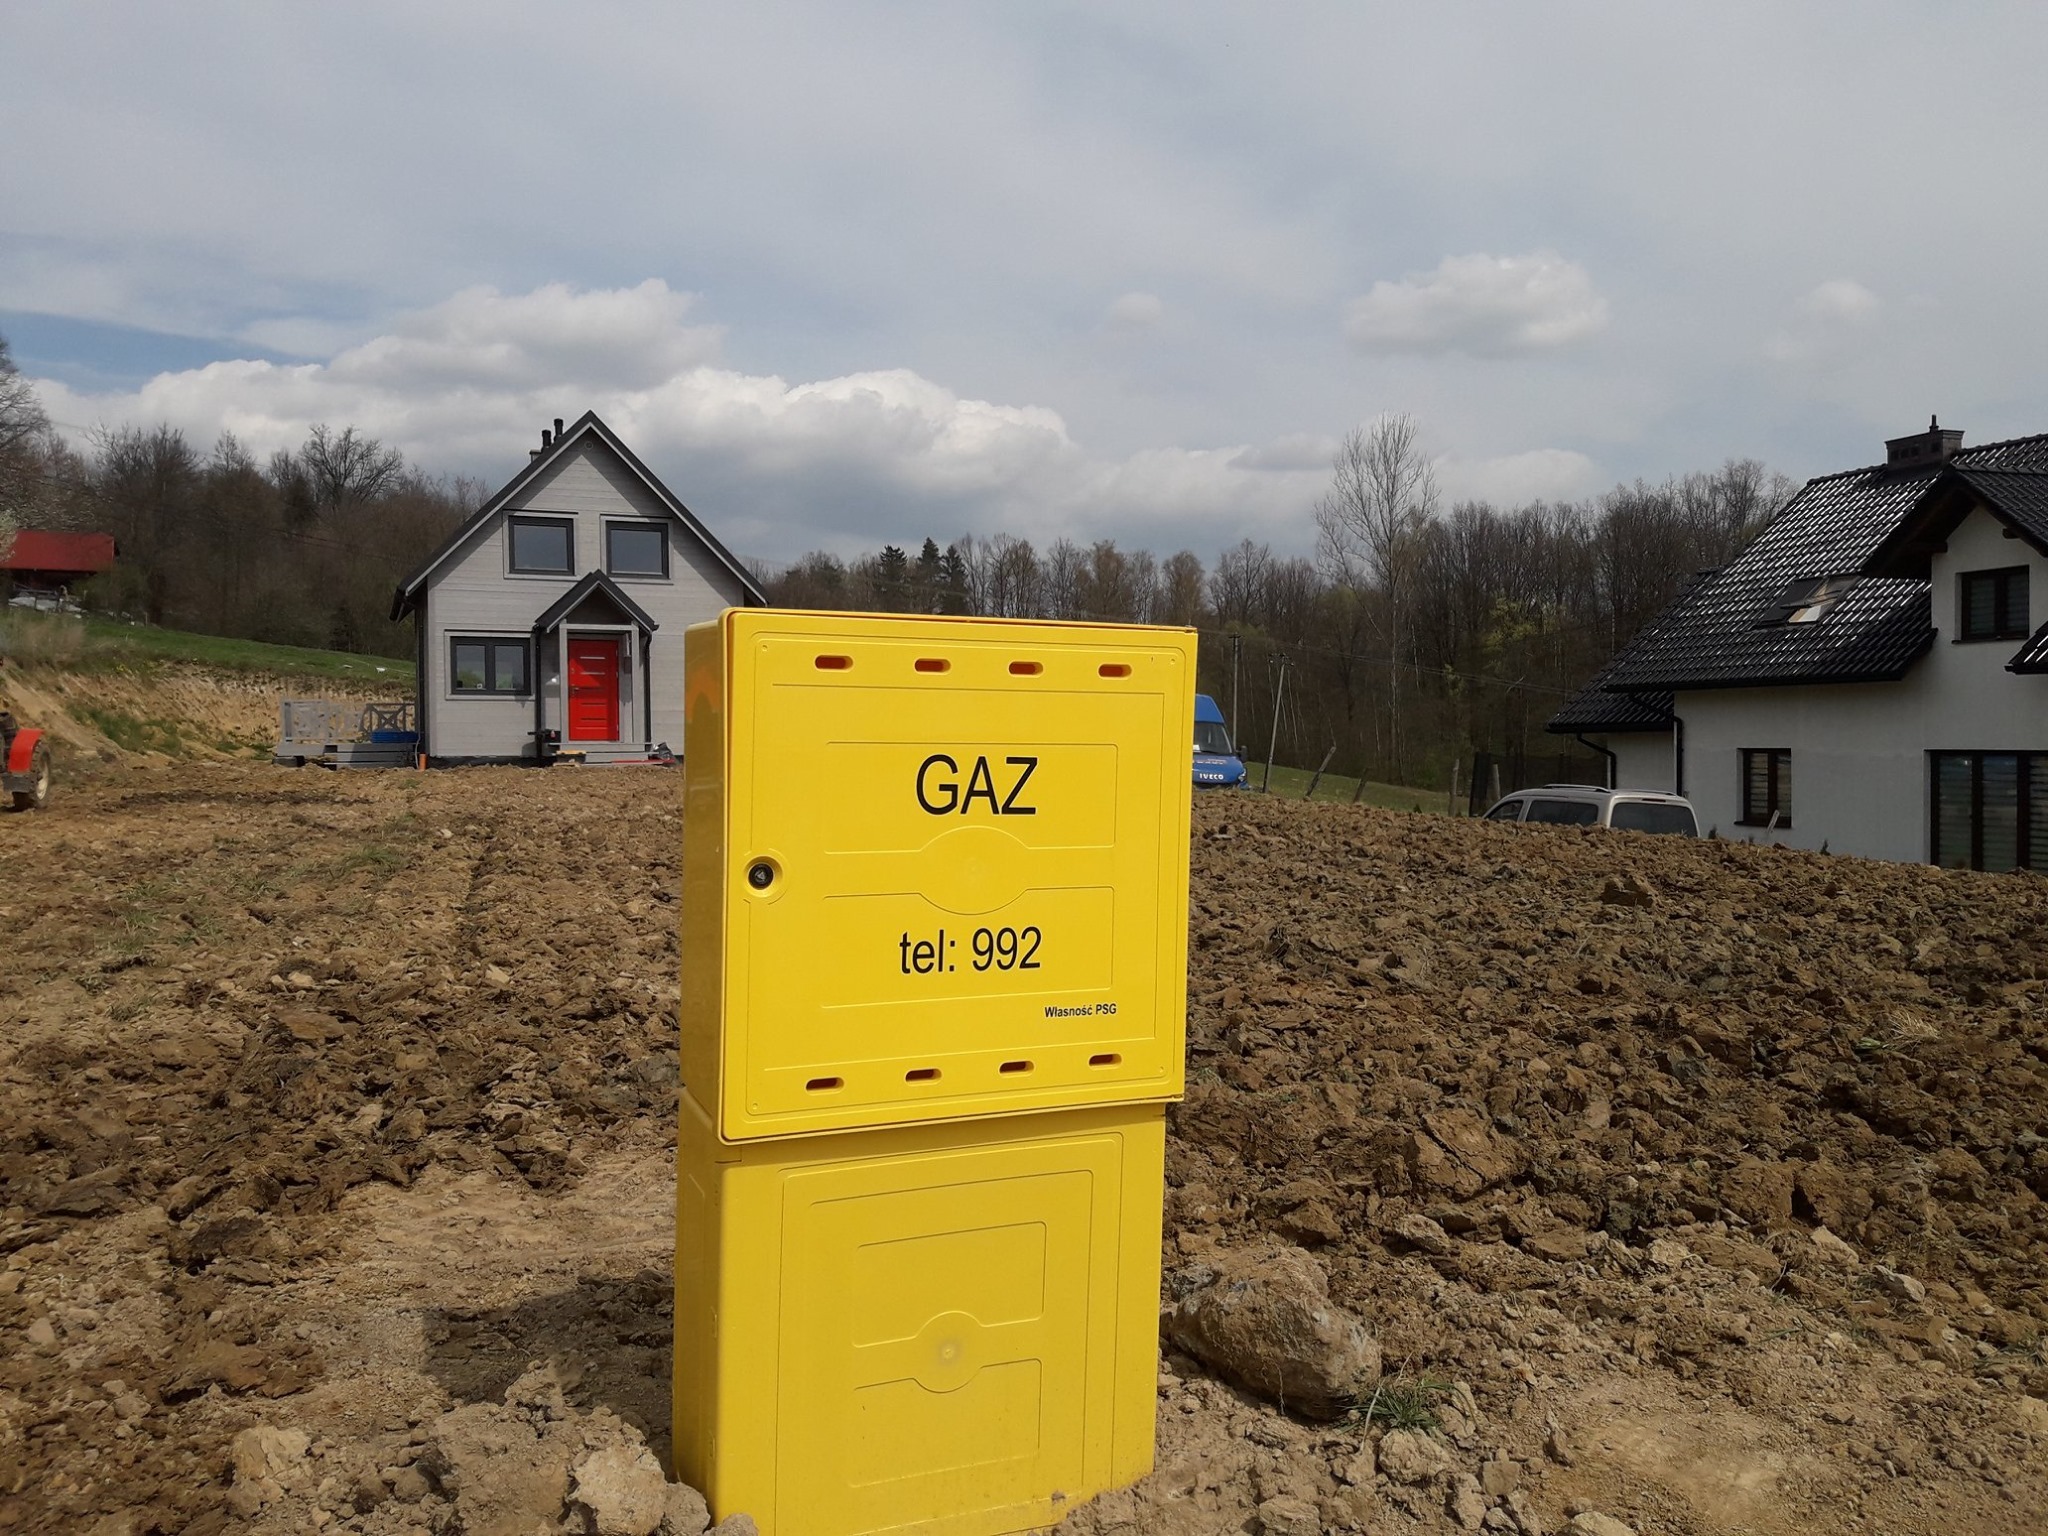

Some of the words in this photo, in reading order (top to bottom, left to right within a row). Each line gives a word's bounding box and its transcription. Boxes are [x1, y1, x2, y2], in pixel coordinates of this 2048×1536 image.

[916, 754, 1038, 816] GAZ
[899, 929, 956, 974] tel:
[972, 926, 1042, 972] 992
[1044, 1004, 1093, 1018] Własność
[1095, 1003, 1117, 1015] PSG
